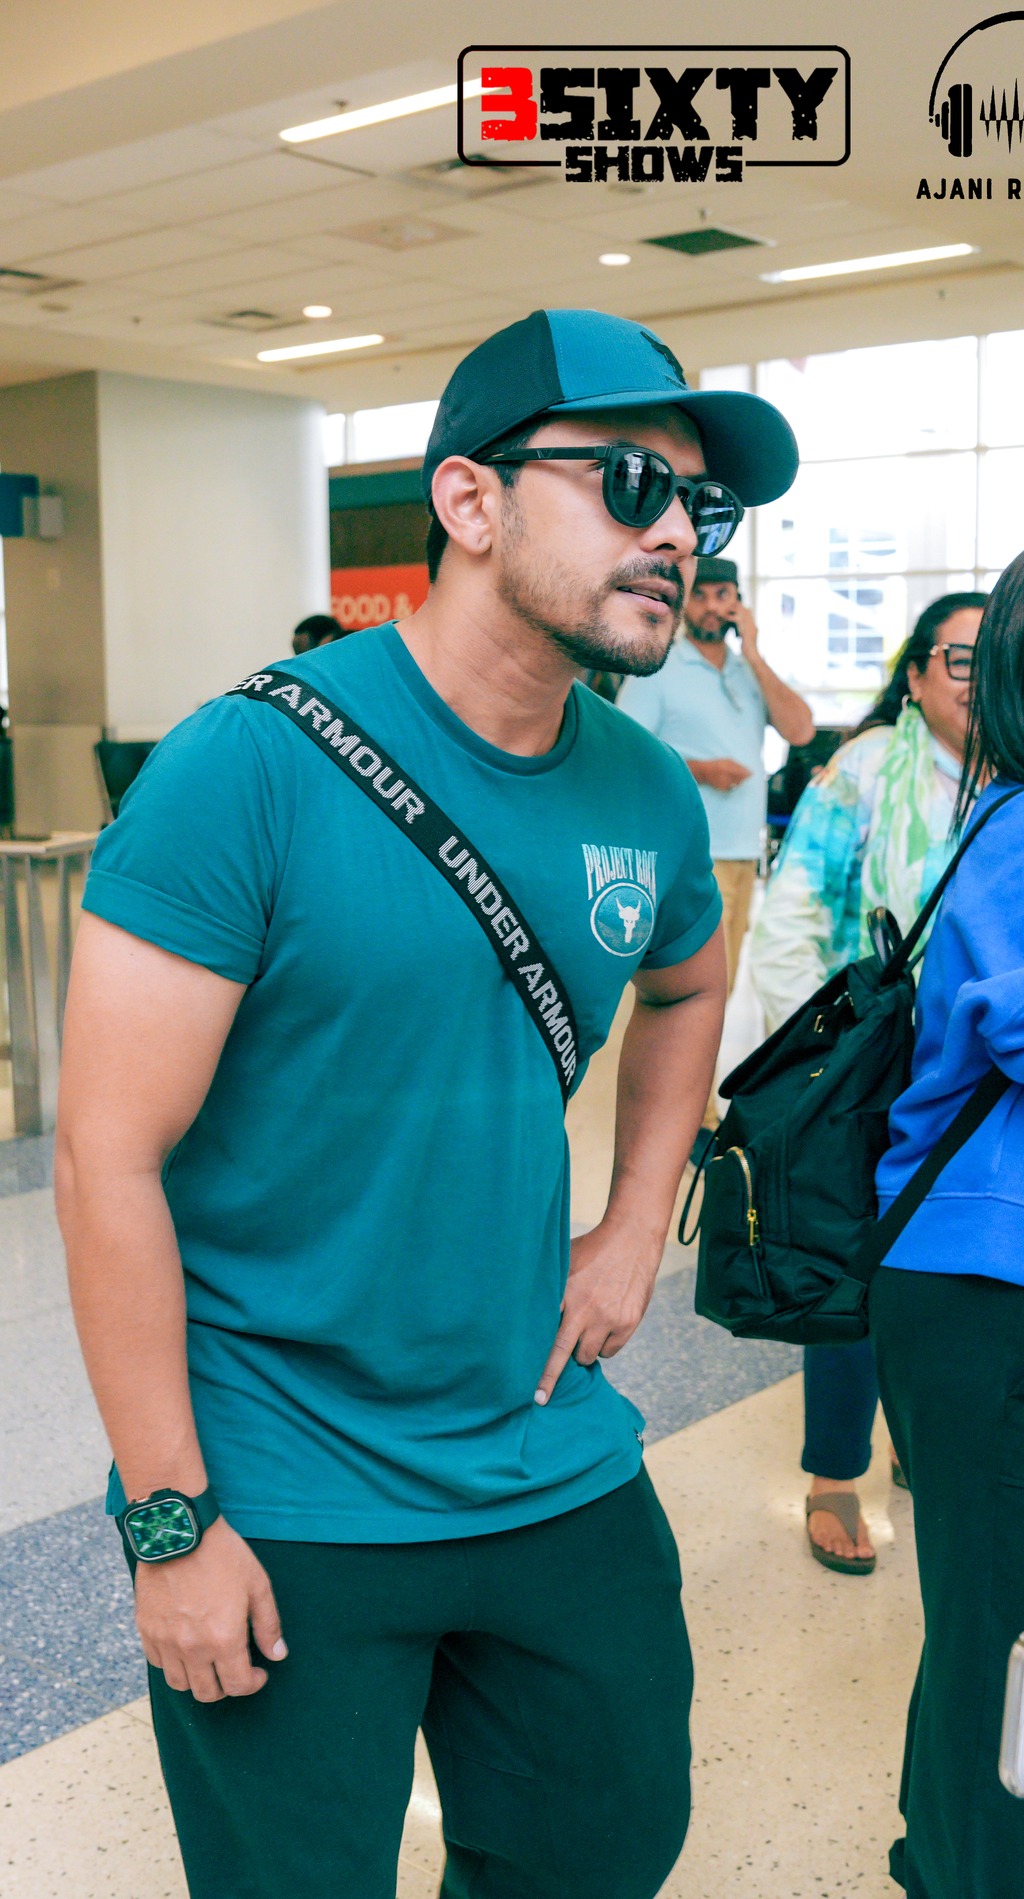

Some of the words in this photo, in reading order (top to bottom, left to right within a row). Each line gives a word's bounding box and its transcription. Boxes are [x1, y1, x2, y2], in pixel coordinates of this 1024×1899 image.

[267, 683, 426, 825] ARMOUR
[438, 835, 530, 961] UNDER
[517, 962, 577, 1087] ARMOUR
[581, 843, 635, 901] PROJECT
